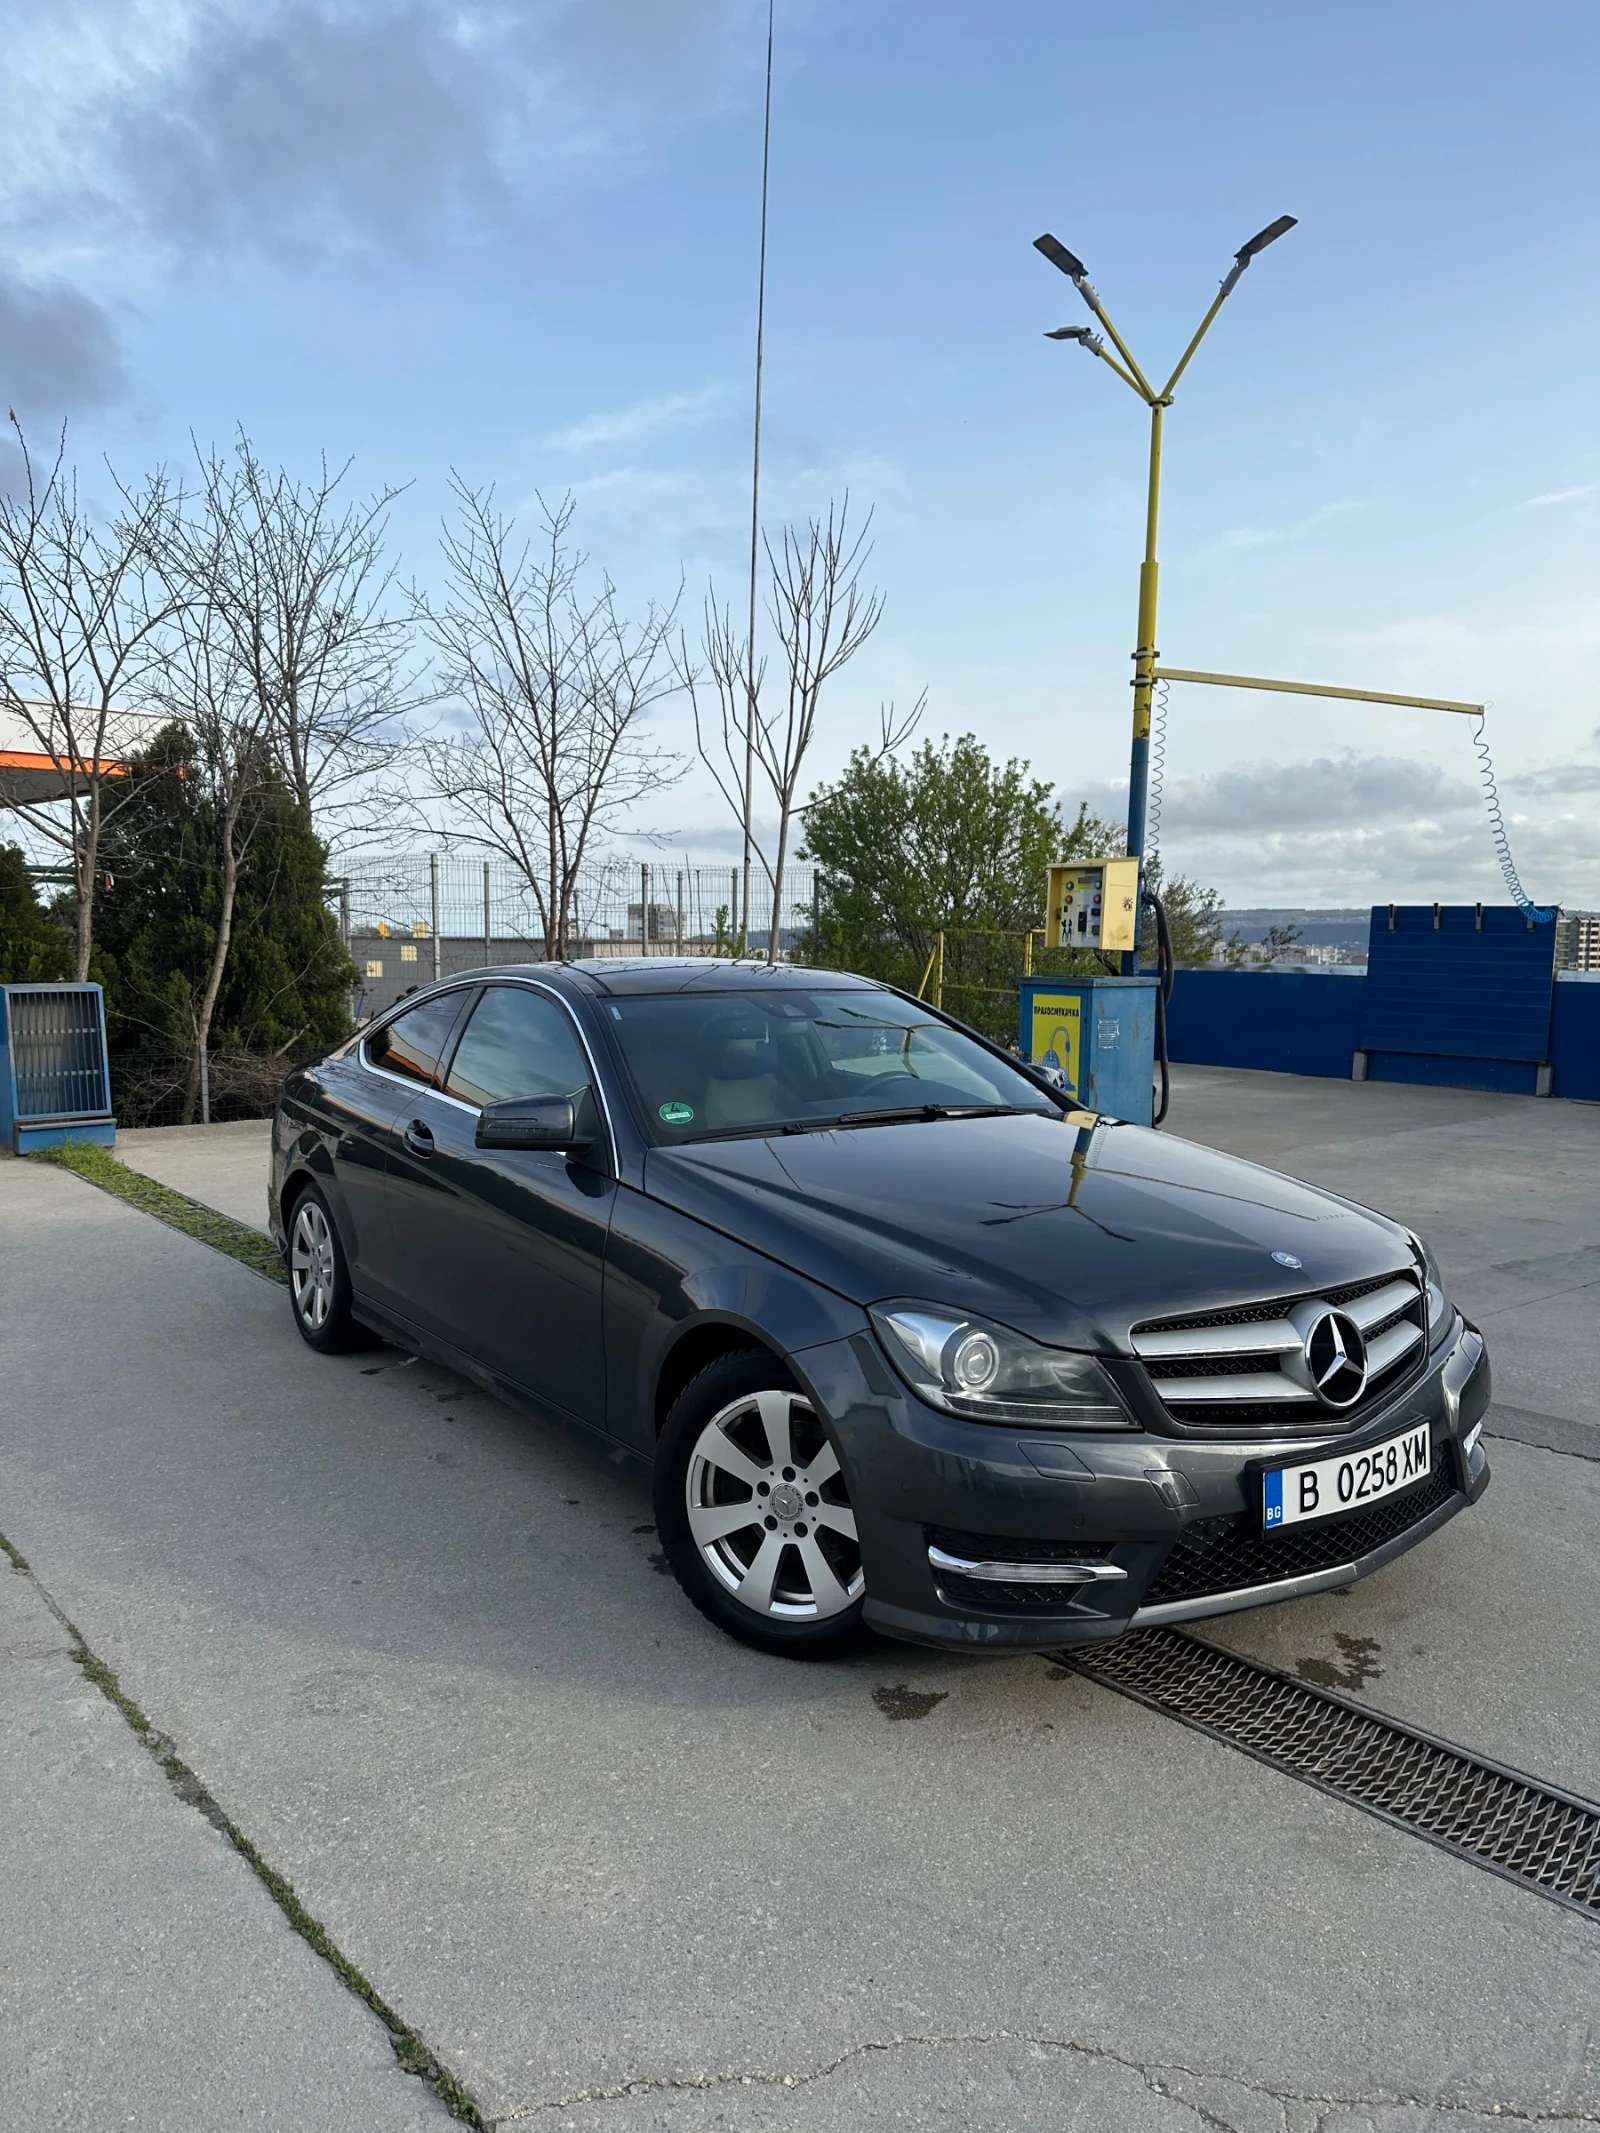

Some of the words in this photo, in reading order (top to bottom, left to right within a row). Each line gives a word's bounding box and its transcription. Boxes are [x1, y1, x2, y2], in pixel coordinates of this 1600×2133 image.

[671, 1103, 680, 1113] 4
[1299, 1470, 1320, 1514] B
[1338, 1446, 1398, 1503] 0258
[1402, 1430, 1427, 1480] XM
[1266, 1506, 1282, 1521] BG
